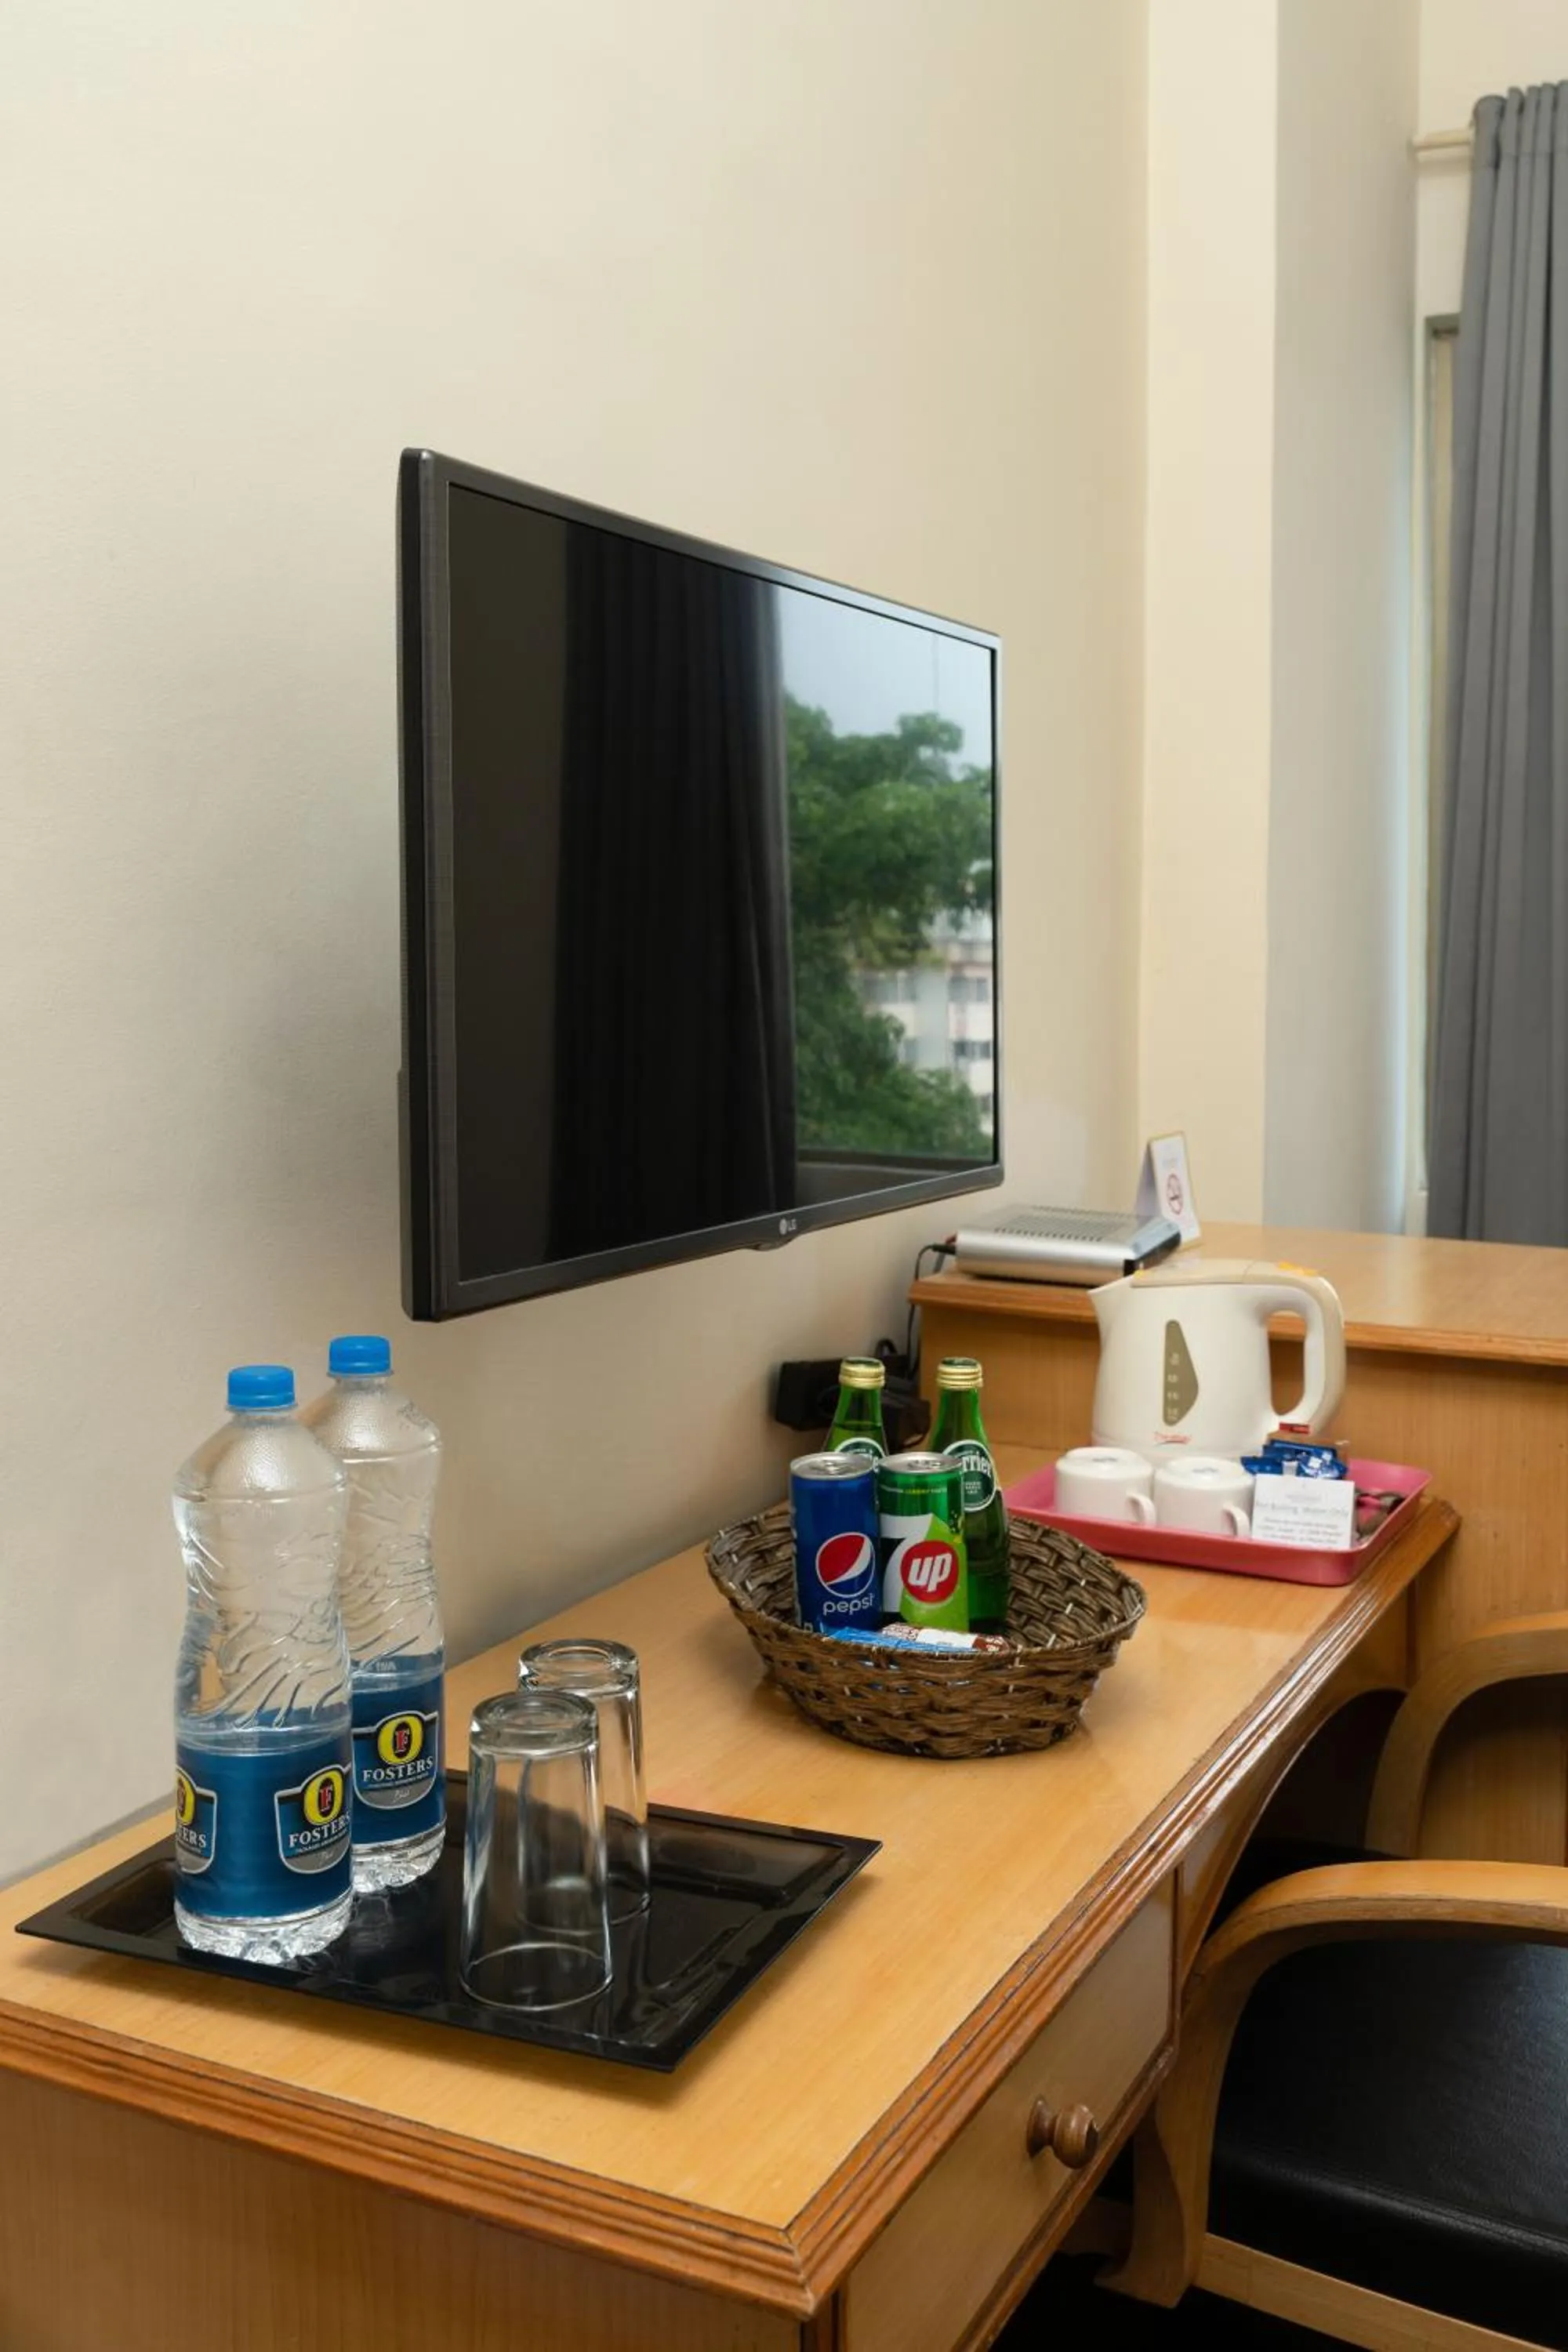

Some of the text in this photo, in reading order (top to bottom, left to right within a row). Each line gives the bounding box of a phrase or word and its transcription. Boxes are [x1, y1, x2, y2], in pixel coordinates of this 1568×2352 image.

[962, 1450, 993, 1477] rrier
[823, 1592, 874, 1616] pepsi
[363, 1755, 434, 1782] FOSTERS
